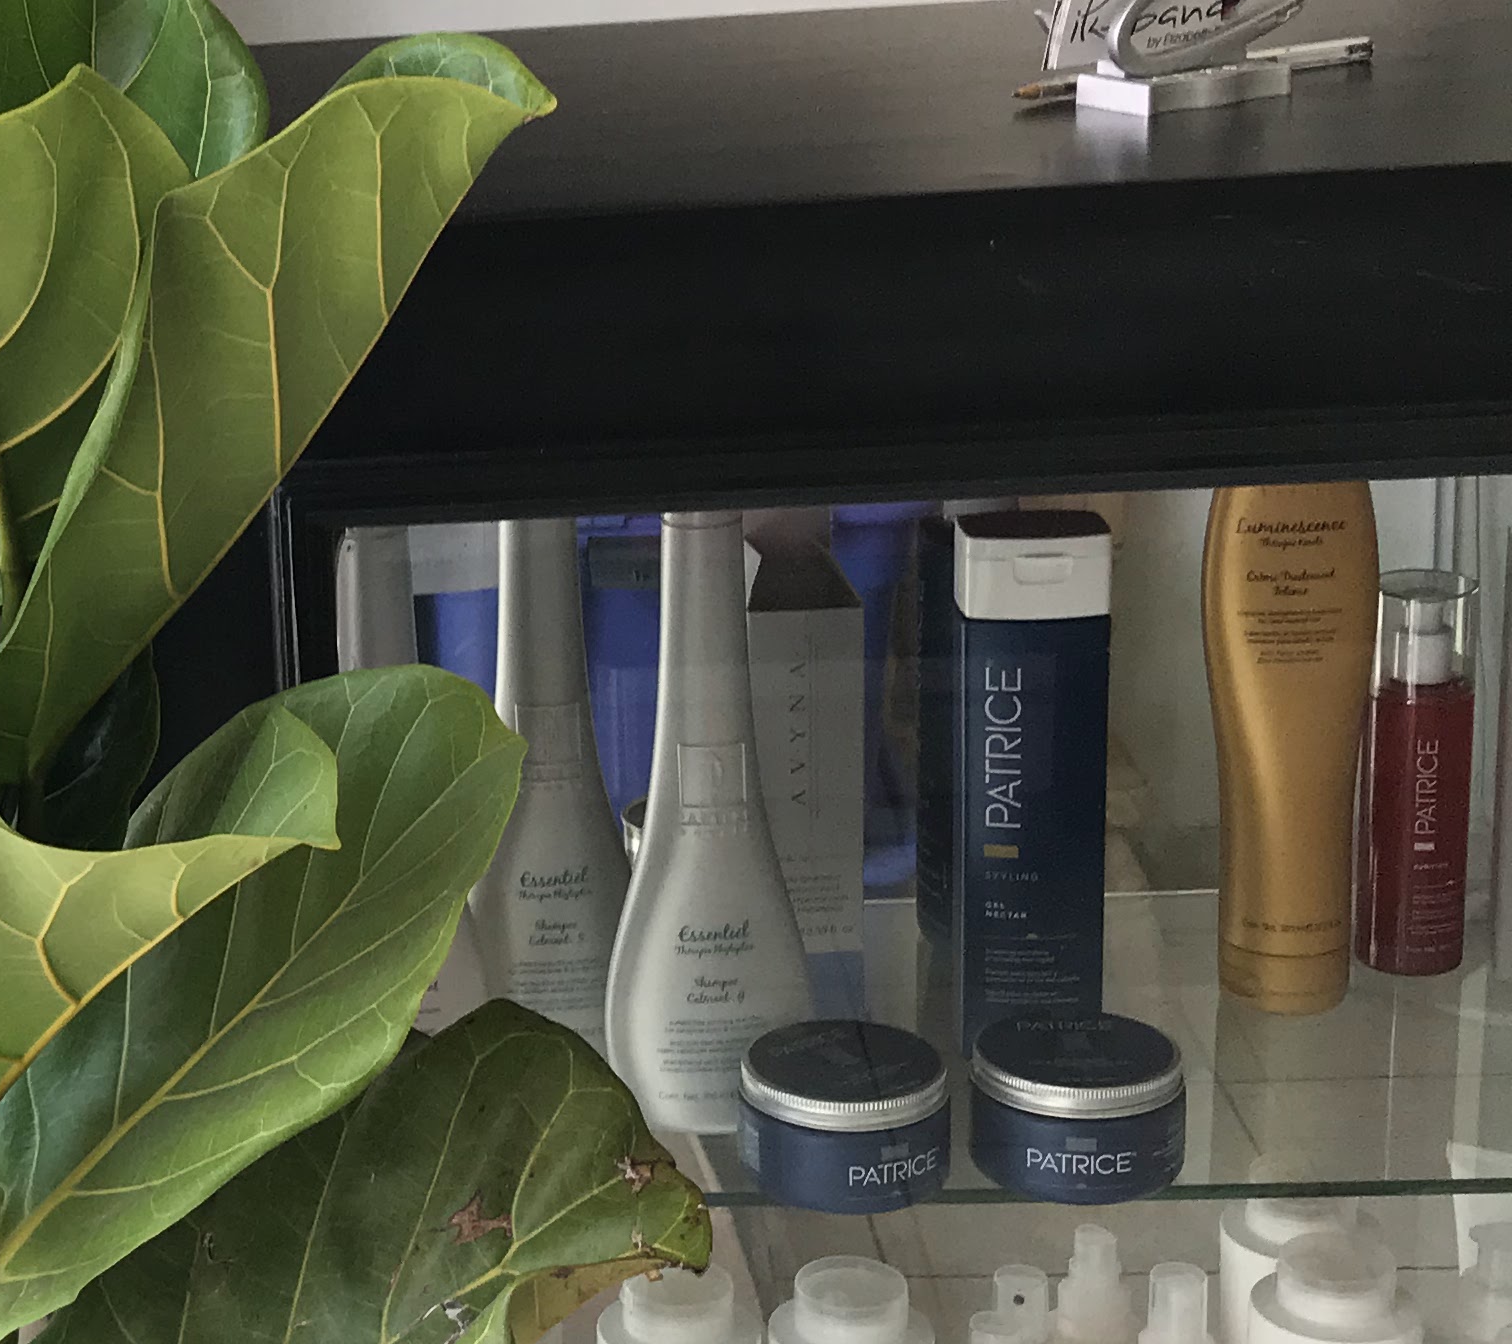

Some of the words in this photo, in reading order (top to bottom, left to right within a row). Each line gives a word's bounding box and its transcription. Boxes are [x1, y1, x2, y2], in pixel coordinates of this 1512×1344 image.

[984, 667, 1022, 829] PATRICE
[1414, 739, 1439, 835] PATRICE
[848, 1147, 938, 1187] PATRICE
[1026, 1147, 1133, 1177] PATRICE
